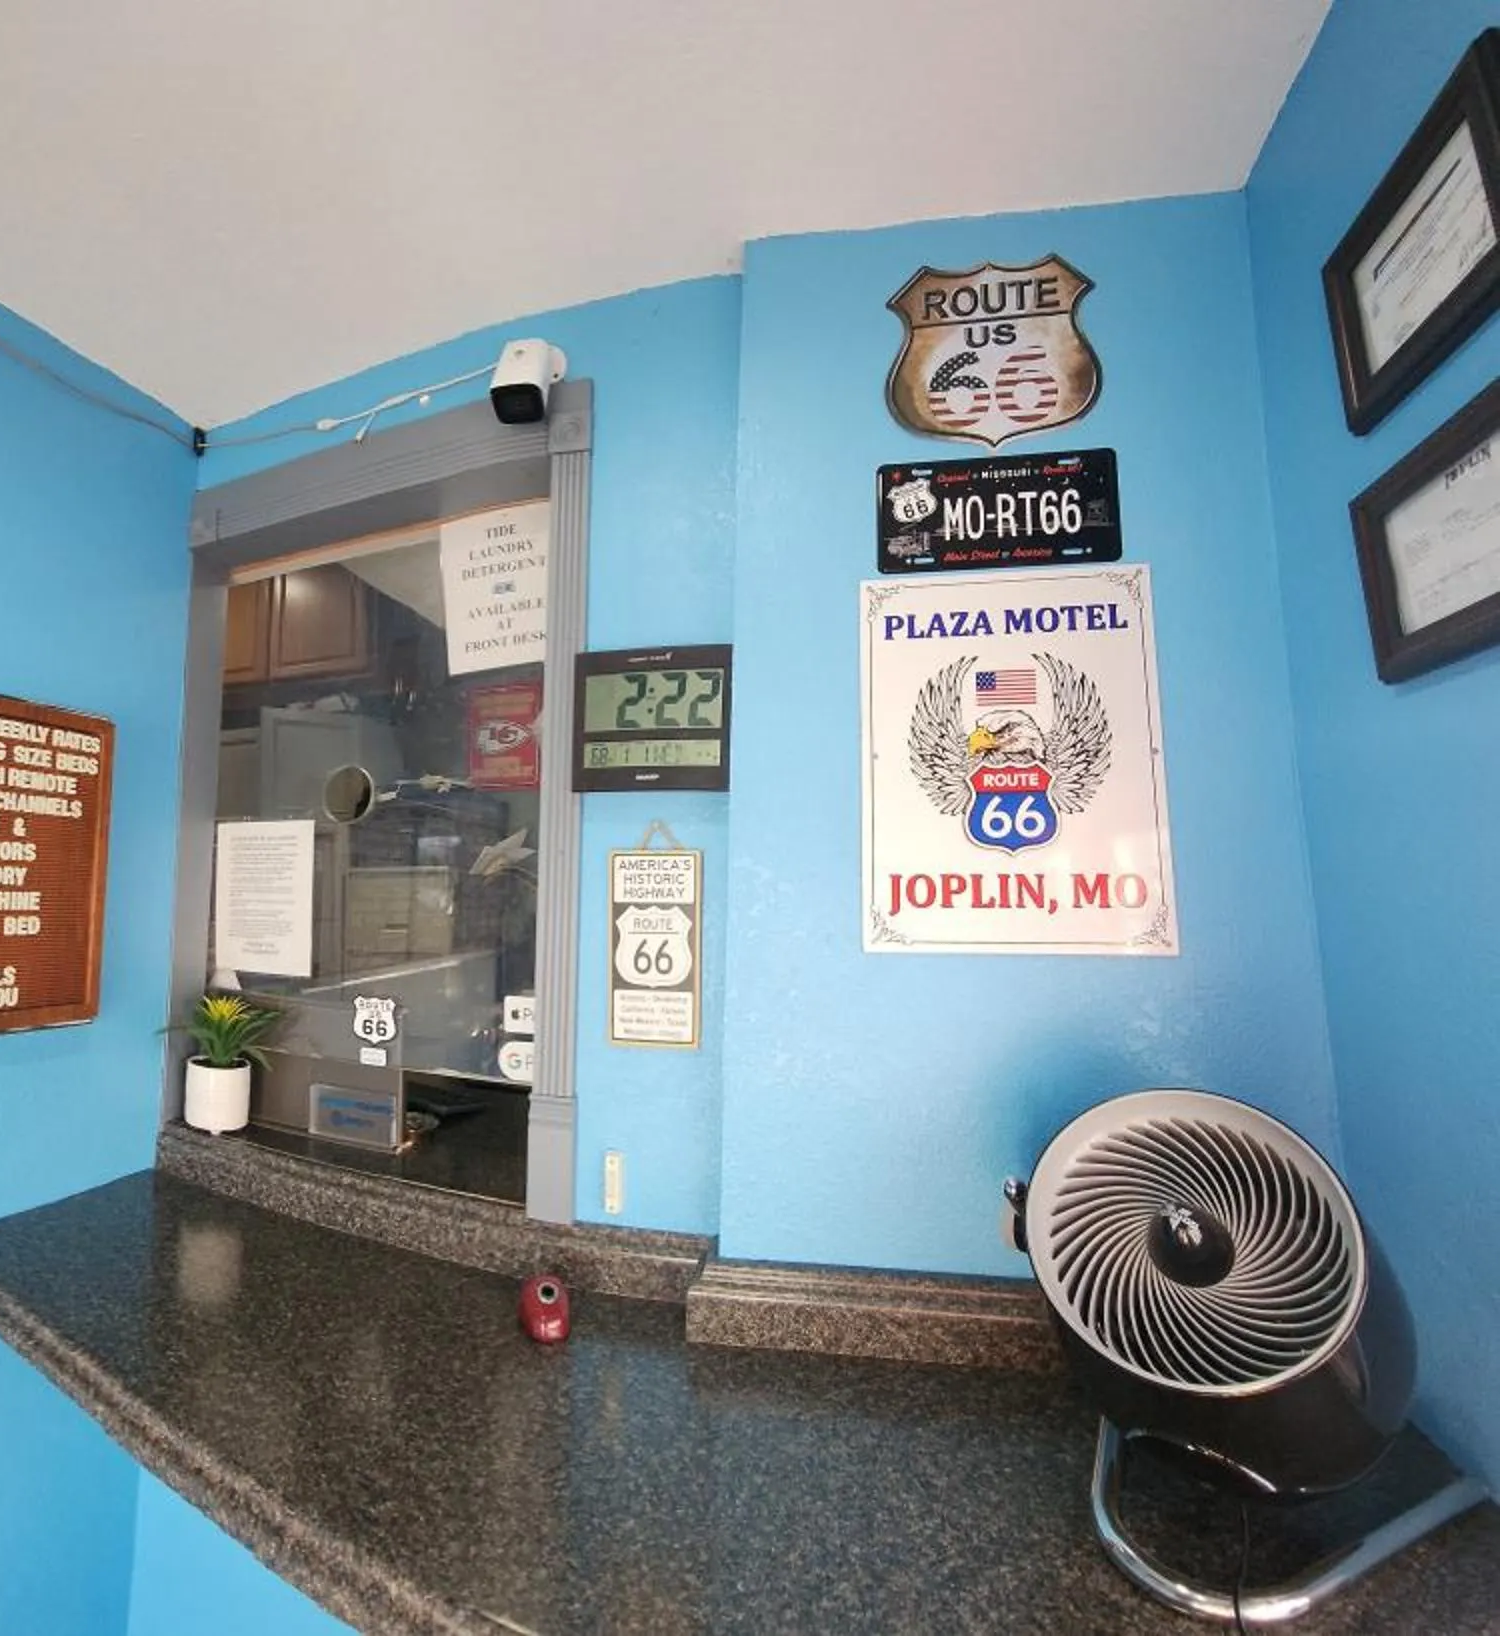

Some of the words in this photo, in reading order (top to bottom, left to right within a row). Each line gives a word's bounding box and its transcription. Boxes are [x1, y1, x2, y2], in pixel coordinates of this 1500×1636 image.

[921, 277, 1061, 321] ROUTE
[964, 323, 1017, 348] US
[928, 345, 1059, 427] 66
[903, 499, 928, 519] 66
[944, 488, 1082, 541] MO-RT66
[486, 524, 517, 539] TIDE
[469, 539, 533, 560] LAUNDRY
[462, 555, 546, 581] DETERGENT
[468, 598, 544, 619] AVAILABLE
[498, 617, 514, 630] AT
[884, 611, 994, 641] PLAZA
[1004, 604, 1129, 634] MOTEL
[465, 636, 508, 653] FRONT
[513, 631, 547, 645] DESK
[616, 672, 721, 728] 2:22
[52, 730, 100, 754] RATES
[13, 745, 53, 767] SIZE
[56, 752, 99, 775] BEDS
[8, 768, 78, 794] REMOTE
[983, 773, 1041, 788] ROUTE
[13, 818, 26, 836] &
[981, 796, 1046, 838] 66
[619, 860, 691, 870] AMERICA'S
[623, 873, 685, 885] HISTORIC
[623, 887, 685, 899] HIGHWAY
[888, 873, 1058, 916] JOPLIN,
[1071, 873, 1147, 909] MO
[3, 917, 40, 936] BED
[634, 918, 673, 930] ROUTE
[633, 939, 673, 974] 66
[359, 999, 391, 1010] ROUTE
[363, 1020, 387, 1036] 66
